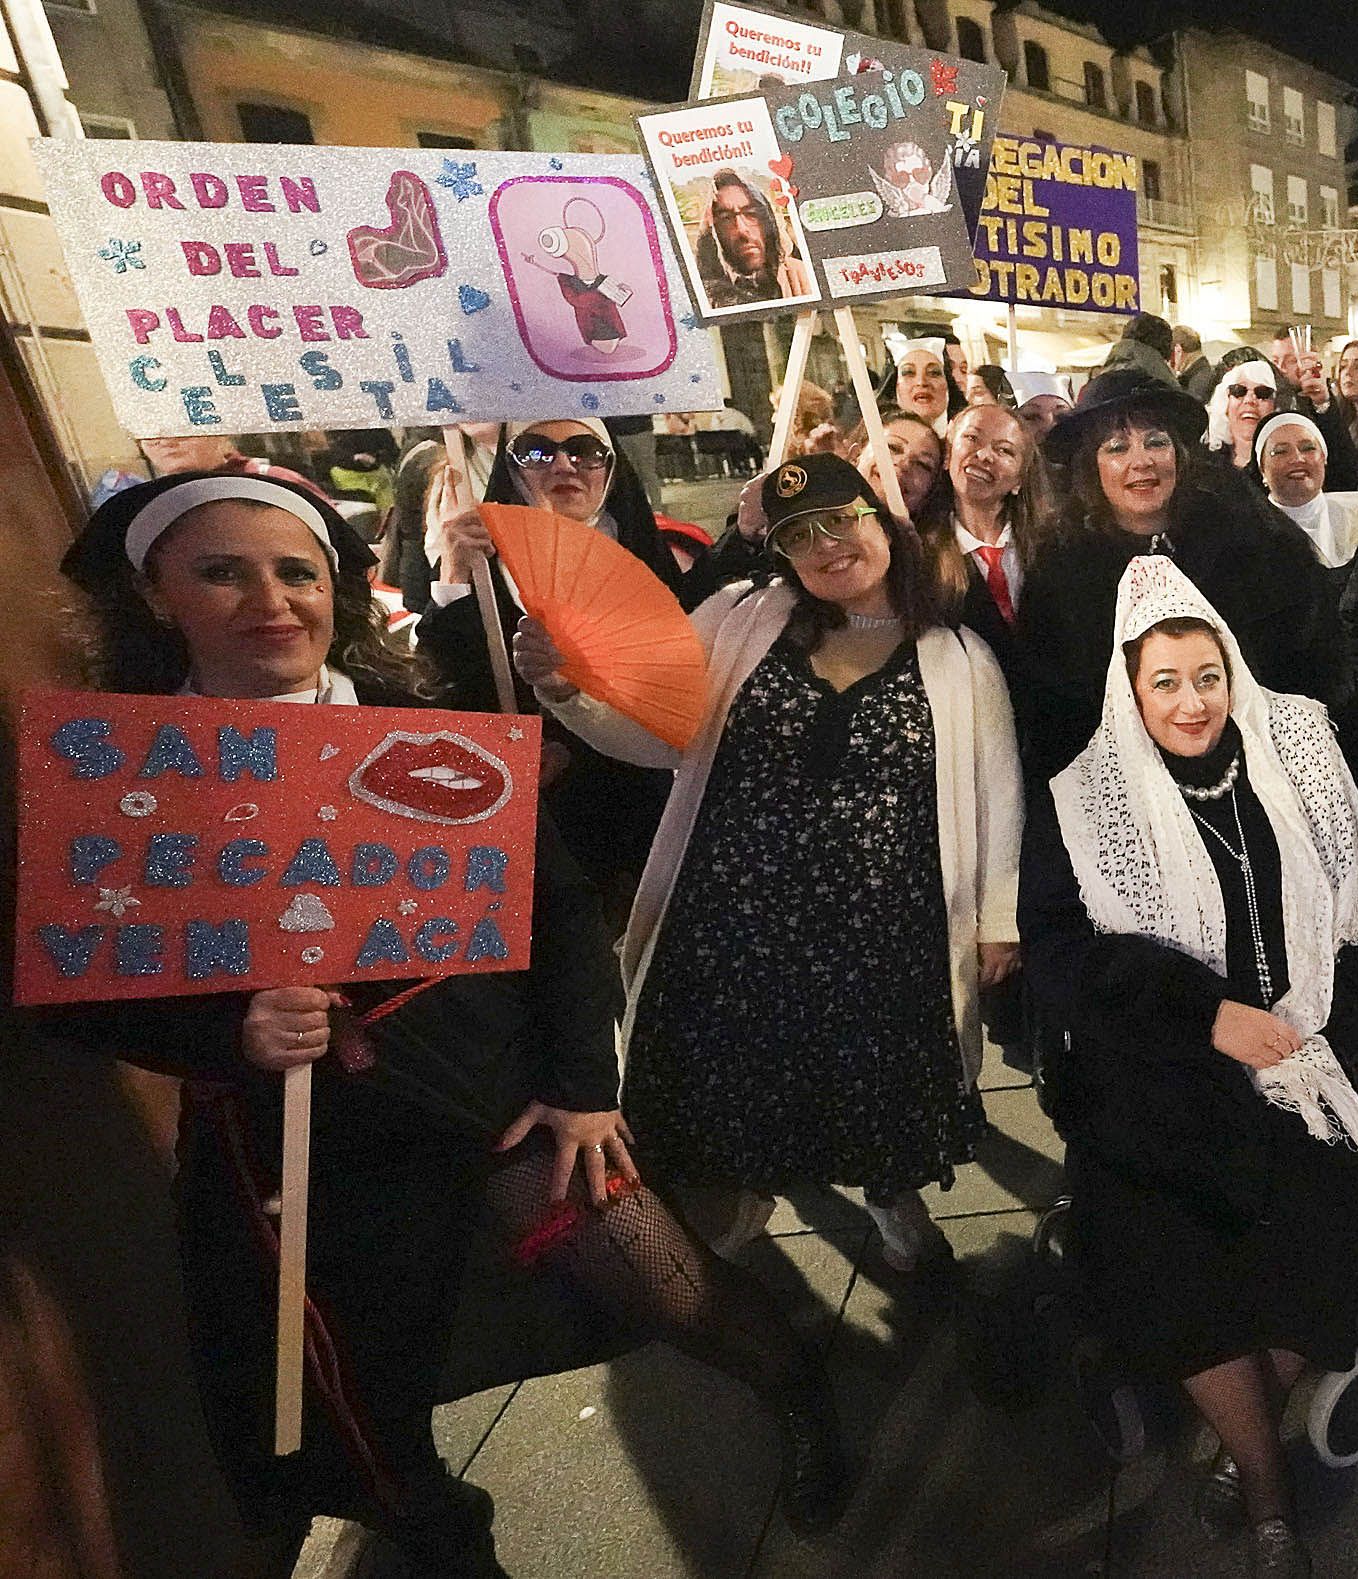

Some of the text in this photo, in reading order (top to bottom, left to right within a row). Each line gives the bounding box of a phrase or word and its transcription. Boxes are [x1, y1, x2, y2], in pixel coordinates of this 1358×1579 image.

[725, 20, 822, 57] Queremos tu
[729, 42, 812, 74] bendición!!
[776, 69, 925, 143] COLEGIO
[658, 120, 753, 147] Queremos tu
[672, 141, 753, 168] bendición!!
[989, 138, 1137, 191] EGACION
[101, 171, 322, 213] ORDEN
[180, 240, 300, 278] DEL
[126, 304, 370, 344] PLACER
[51, 718, 279, 783] SAN
[70, 832, 509, 893] PECADOR
[40, 901, 509, 979] VEN ACÁ
